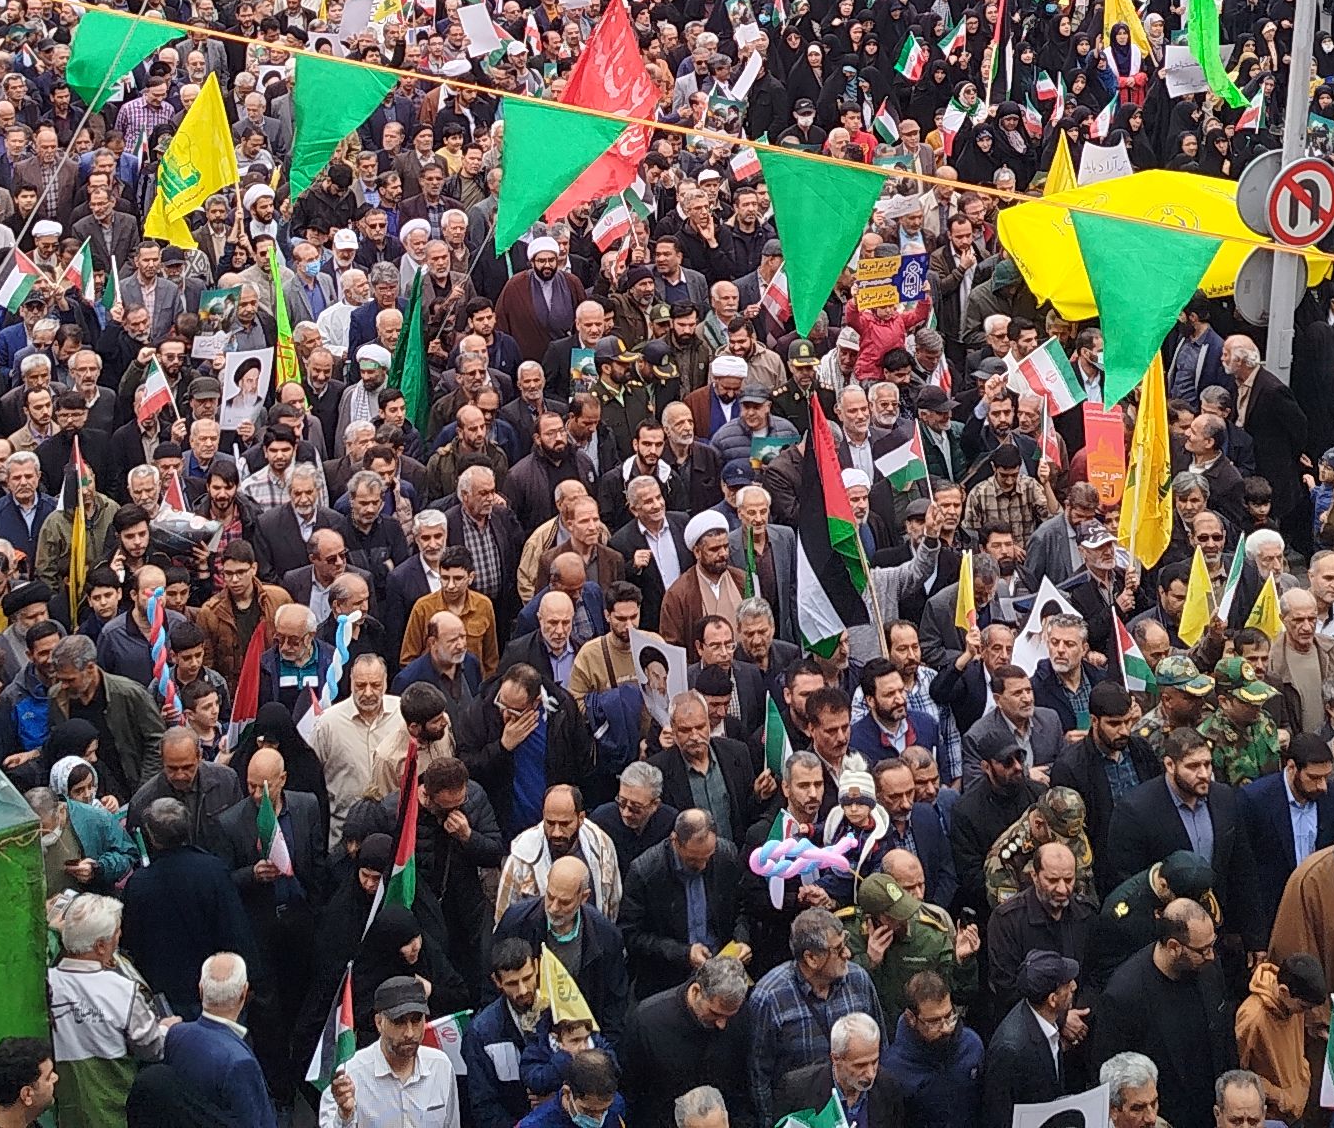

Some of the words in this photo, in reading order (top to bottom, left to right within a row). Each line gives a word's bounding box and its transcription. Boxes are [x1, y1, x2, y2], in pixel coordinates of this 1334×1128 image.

[858, 261, 878, 271] آمریکا
[884, 260, 897, 268] مرگ
[883, 290, 896, 298] مرگ
